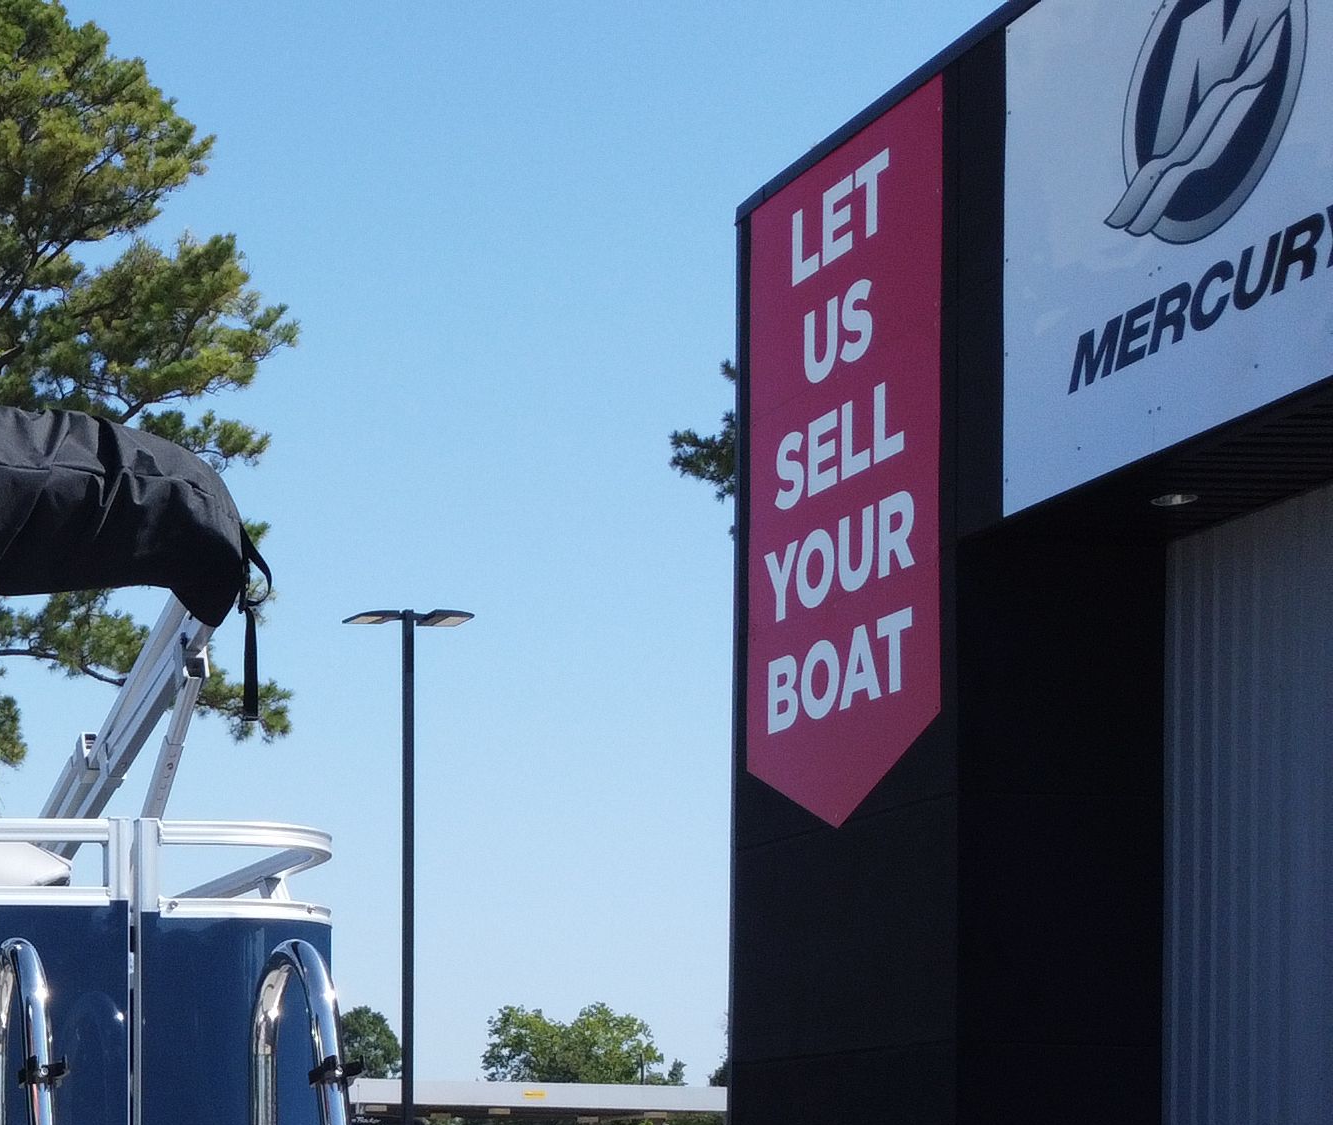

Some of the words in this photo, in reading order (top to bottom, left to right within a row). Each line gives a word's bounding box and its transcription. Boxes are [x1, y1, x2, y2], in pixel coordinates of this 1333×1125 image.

[791, 147, 890, 287] LET
[803, 278, 873, 384] US
[1068, 204, 1333, 395] MERCUR
[774, 382, 905, 511] SELL
[764, 490, 915, 623] YOUR
[767, 606, 913, 734] BOAT
